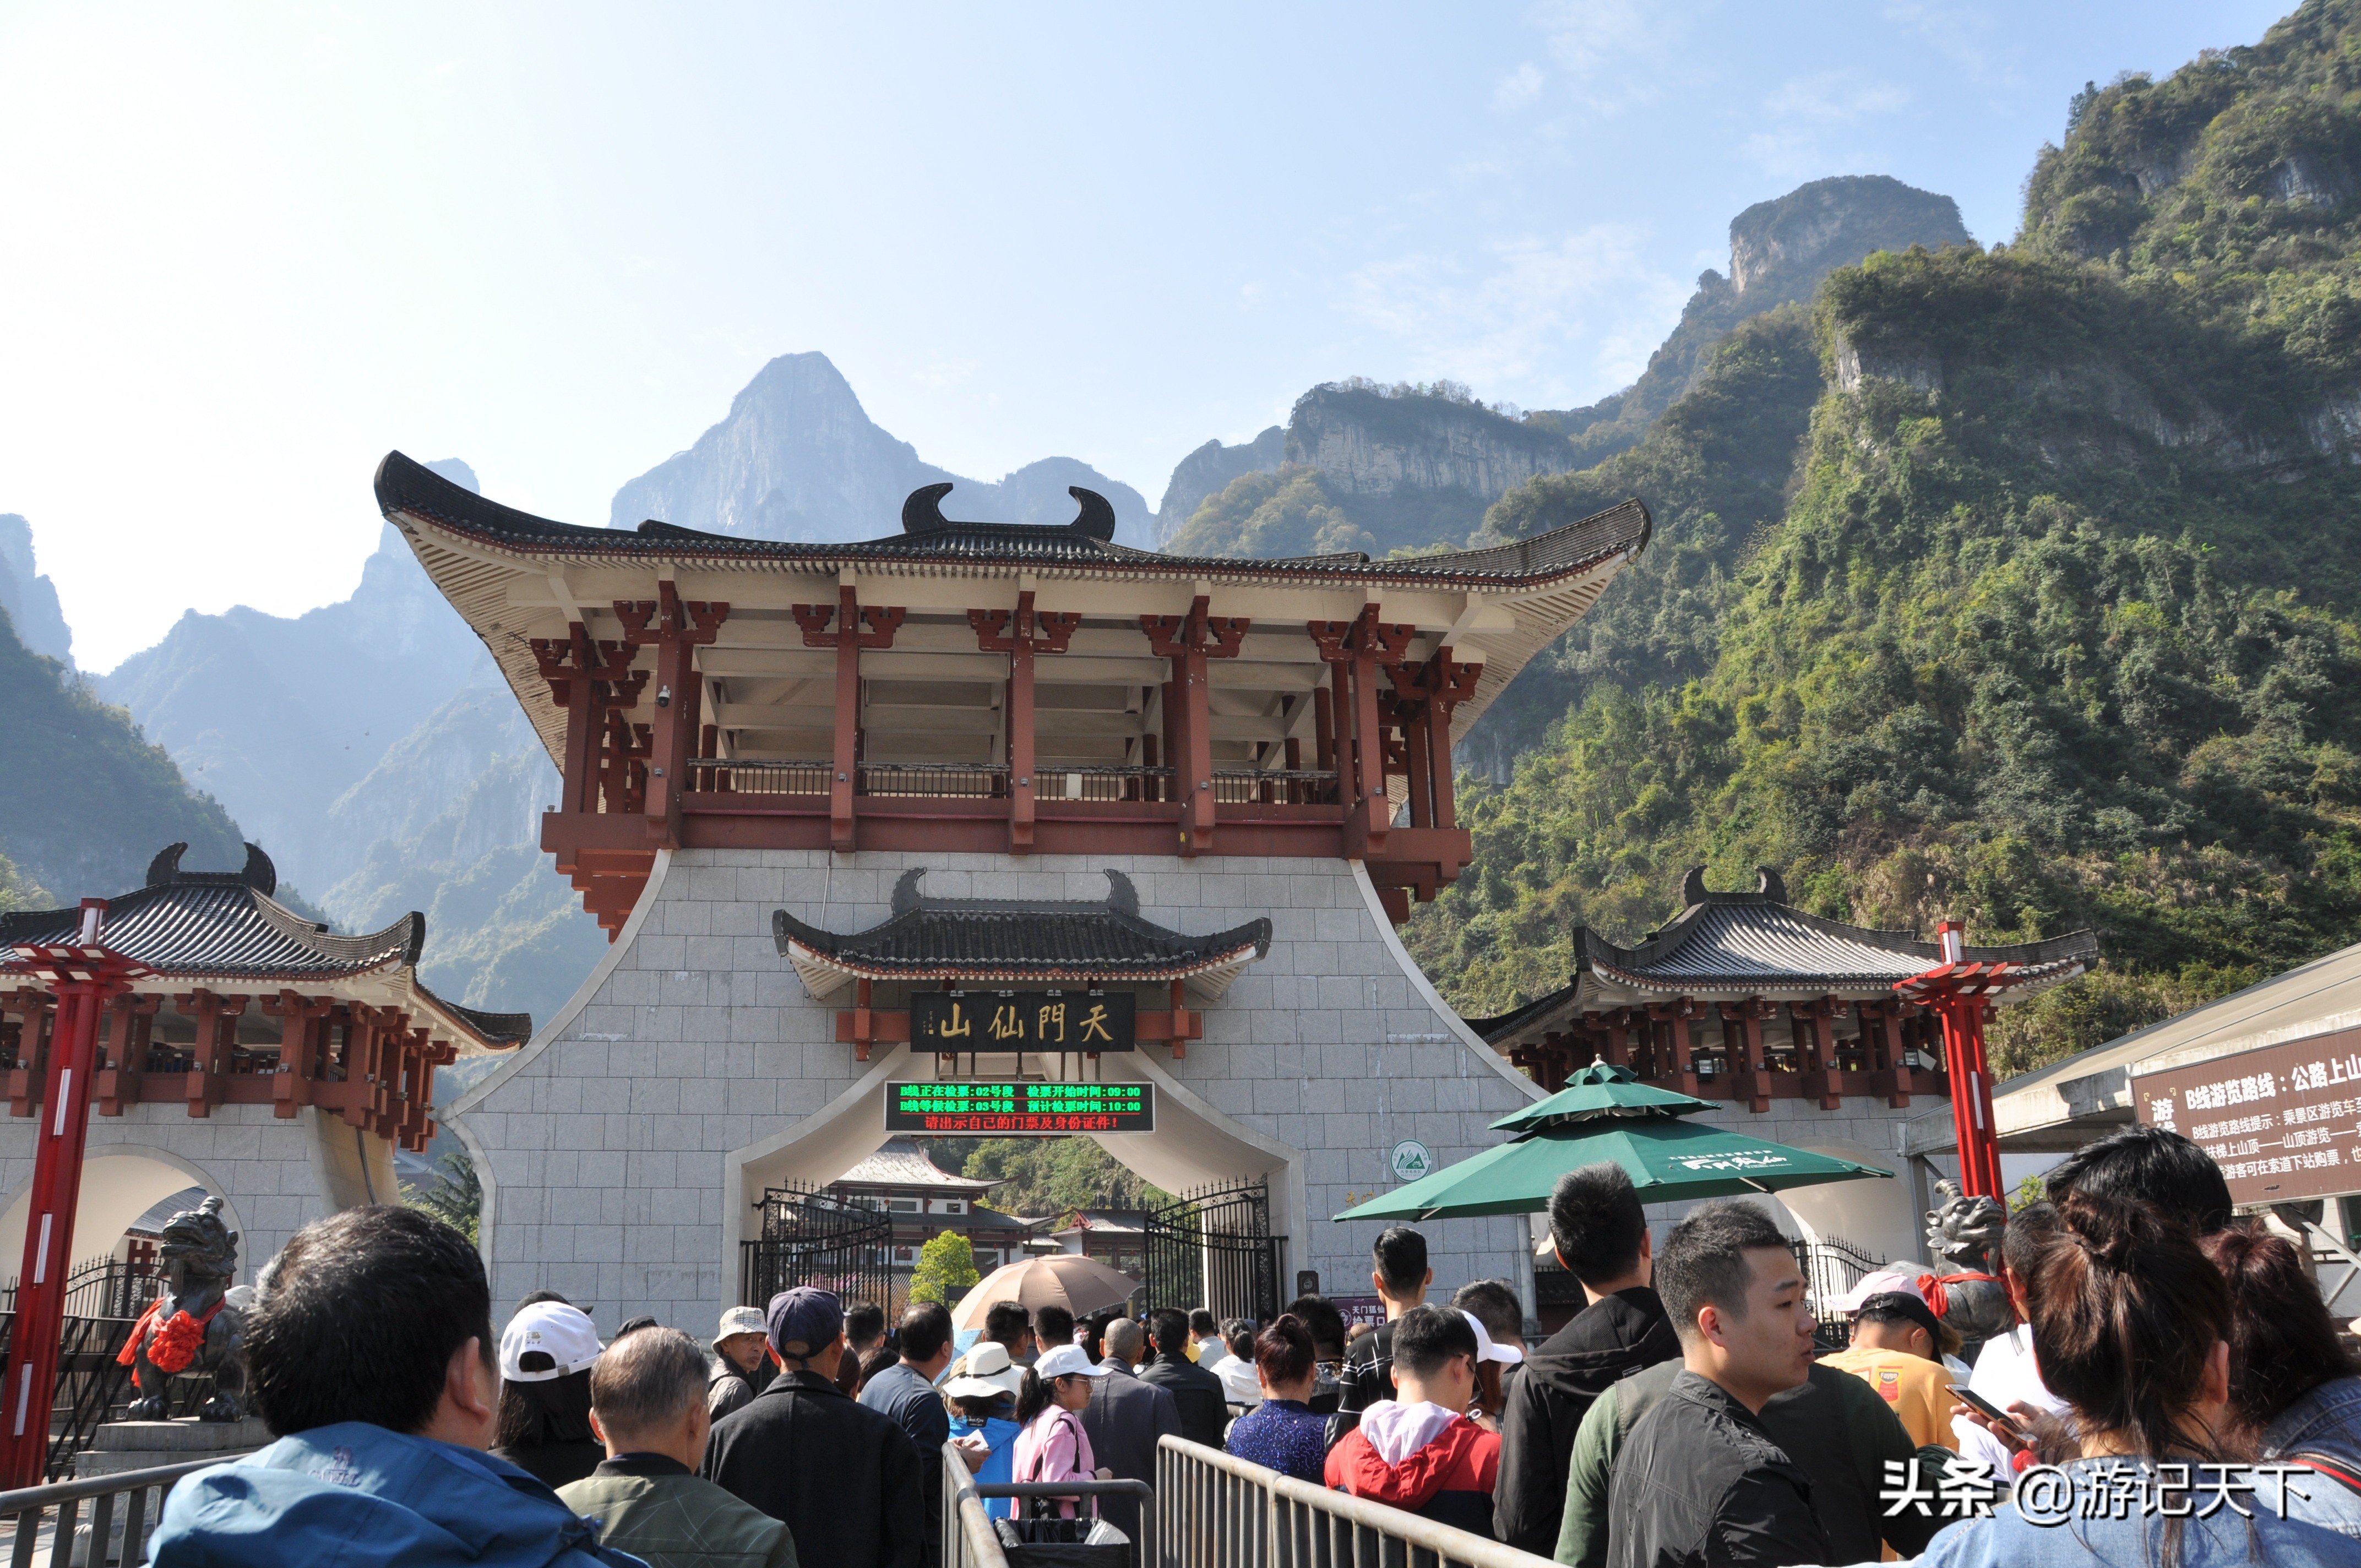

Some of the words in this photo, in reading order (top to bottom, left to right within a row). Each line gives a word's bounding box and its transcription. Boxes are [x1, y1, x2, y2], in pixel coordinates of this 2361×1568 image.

[900, 1085, 1015, 1098] B线正在检票:02号段
[1027, 1086, 1140, 1098] 检票开始时间:09:00
[900, 1100, 1015, 1113] B线等候检票:03号段
[1027, 1101, 1140, 1113] 预计检票时间:10:00
[924, 1115, 1118, 1130] 请出示自己的门票及身份证件!
[1352, 1305, 1385, 1314] 天门狐仙
